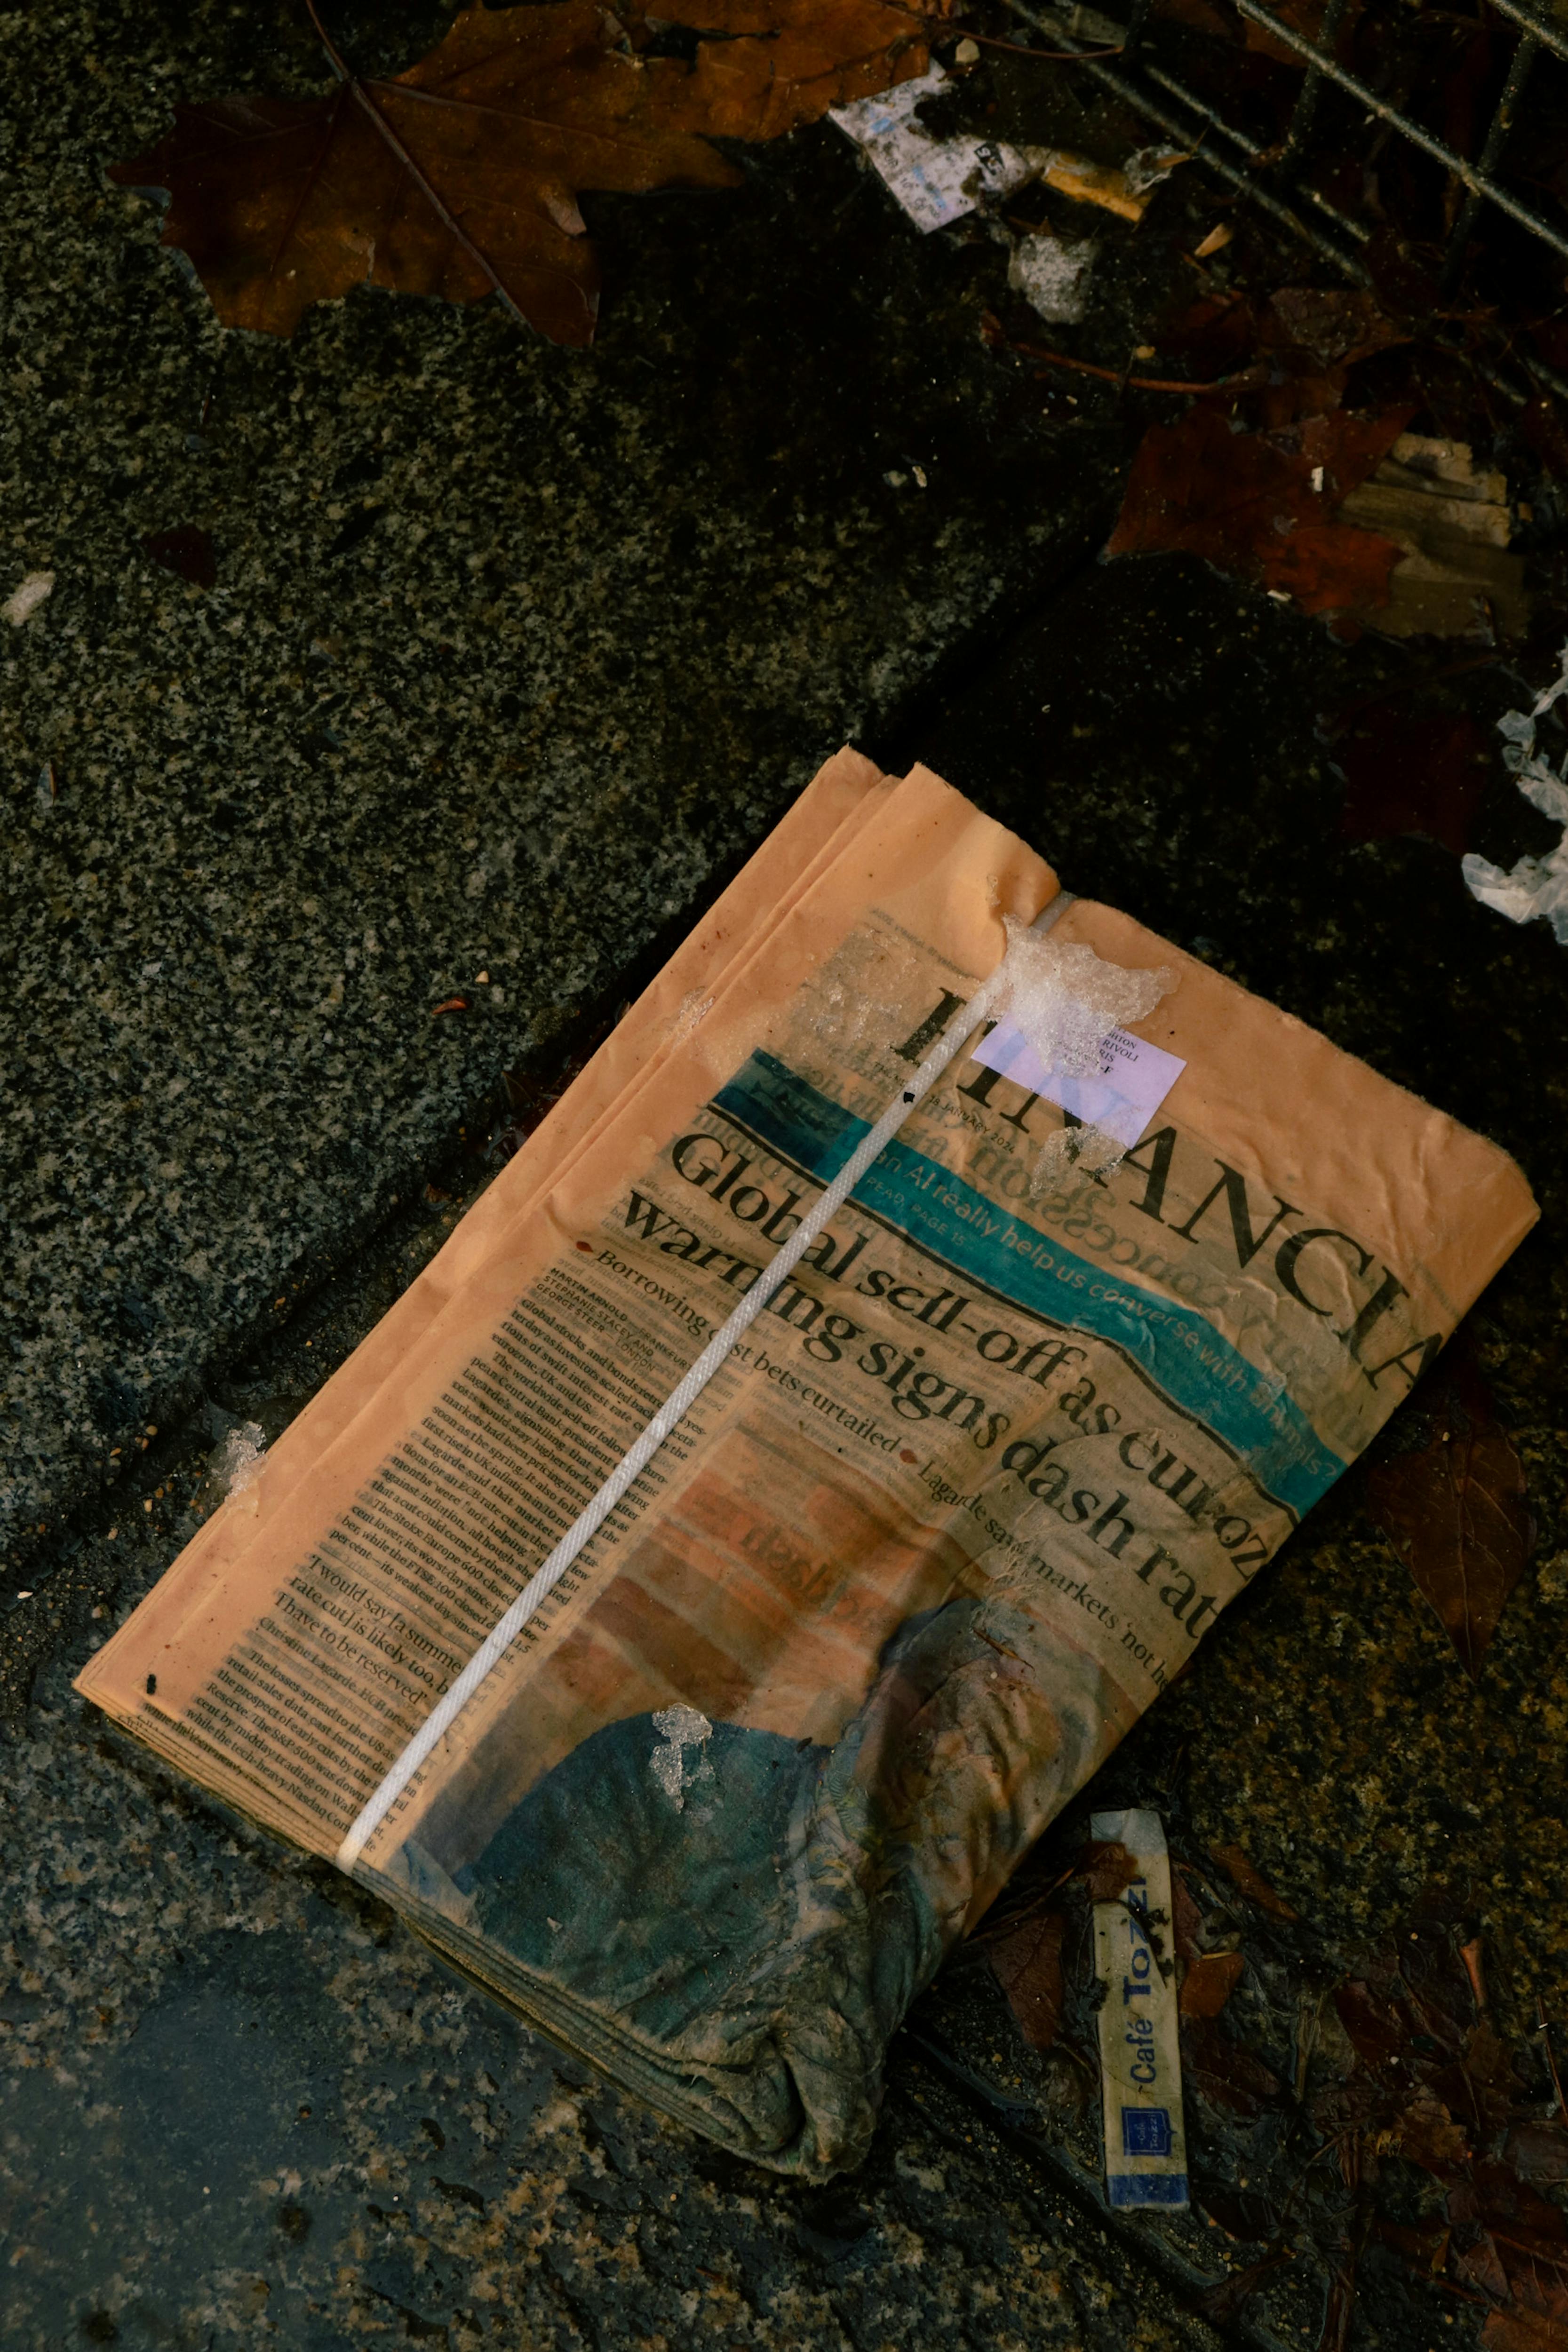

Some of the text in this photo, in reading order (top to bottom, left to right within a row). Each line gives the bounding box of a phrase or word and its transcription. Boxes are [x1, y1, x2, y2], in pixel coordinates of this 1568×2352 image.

[1102, 1039, 1139, 1062] RIVOLI
[929, 1096, 940, 1106] 18
[941, 1103, 990, 1136] JANUARY
[990, 1133, 1017, 1154] 2024
[856, 1138, 903, 1175] an
[931, 1186, 1000, 1238] really
[999, 1224, 1057, 1271] help
[1056, 1266, 1087, 1290] us
[1088, 1283, 1202, 1349] converse
[1201, 1345, 1251, 1392] with
[910, 1203, 949, 1237] PAGE
[950, 1232, 967, 1248] 15
[535, 1282, 655, 1373] GEORGE STEER LONDON
[543, 1274, 655, 1358] STEPHANIE STACEY AND
[550, 1266, 589, 1295] MARTIN
[587, 1291, 629, 1322] ARNOLD
[672, 1128, 869, 1284] Global
[1056, 1376, 1121, 1438] as
[490, 1332, 593, 1414] eurozone, UK and US.
[501, 1320, 688, 1461] tions of swift interest rate the
[511, 1309, 543, 1341] terday
[543, 1335, 556, 1347] as
[555, 1341, 600, 1381] investors
[599, 1377, 632, 1404] scaled
[520, 1297, 556, 1326] Global
[553, 1323, 587, 1351] stocks
[586, 1348, 609, 1367] and
[607, 1362, 639, 1391] bonds
[625, 1191, 865, 1364] warning
[856, 1340, 1012, 1449] signs
[1005, 1437, 1131, 1559] dash
[451, 1380, 478, 1403] costs
[478, 1400, 512, 1427] would
[509, 1423, 532, 1446] stay
[531, 1438, 565, 1469] higher
[564, 1463, 583, 1482] for
[469, 1358, 613, 1466] pean Central Bank president
[492, 1351, 601, 1437] The worldwide sell-off
[514, 1409, 566, 1454] signalling
[568, 1448, 592, 1469] that
[595, 1248, 708, 1333] Borrowing
[753, 1351, 801, 1395] bets
[801, 1391, 900, 1455] curtailed
[917, 1460, 987, 1521] Lagarde
[1028, 1553, 1119, 1630] markets
[317, 1566, 366, 1603] would
[363, 1598, 390, 1626] say
[372, 1498, 550, 1632] The Stoxx Europe 600 closed per
[259, 1616, 312, 1660] Christine
[358, 1688, 386, 1712] ECB
[273, 1591, 287, 1607] I
[280, 1597, 320, 1633] have
[319, 1626, 336, 1645] to
[335, 1636, 357, 1659] be
[289, 1577, 322, 1605] rate
[351, 1617, 366, 1636] is
[366, 1627, 407, 1670] likely
[206, 1681, 366, 1803] Reserve. The S&P 500 was down
[217, 1669, 372, 1787] the prospect of early cuts by the
[226, 1657, 259, 1682] retail
[257, 1679, 284, 1701] sales
[283, 1696, 309, 1719] data
[309, 1716, 333, 1736] cast
[332, 1731, 372, 1764] further
[248, 1650, 395, 1762] The losses spread to the US as
[195, 1697, 357, 1817] cent by midday trading on Wall
[1126, 2018, 1156, 2084] Café
